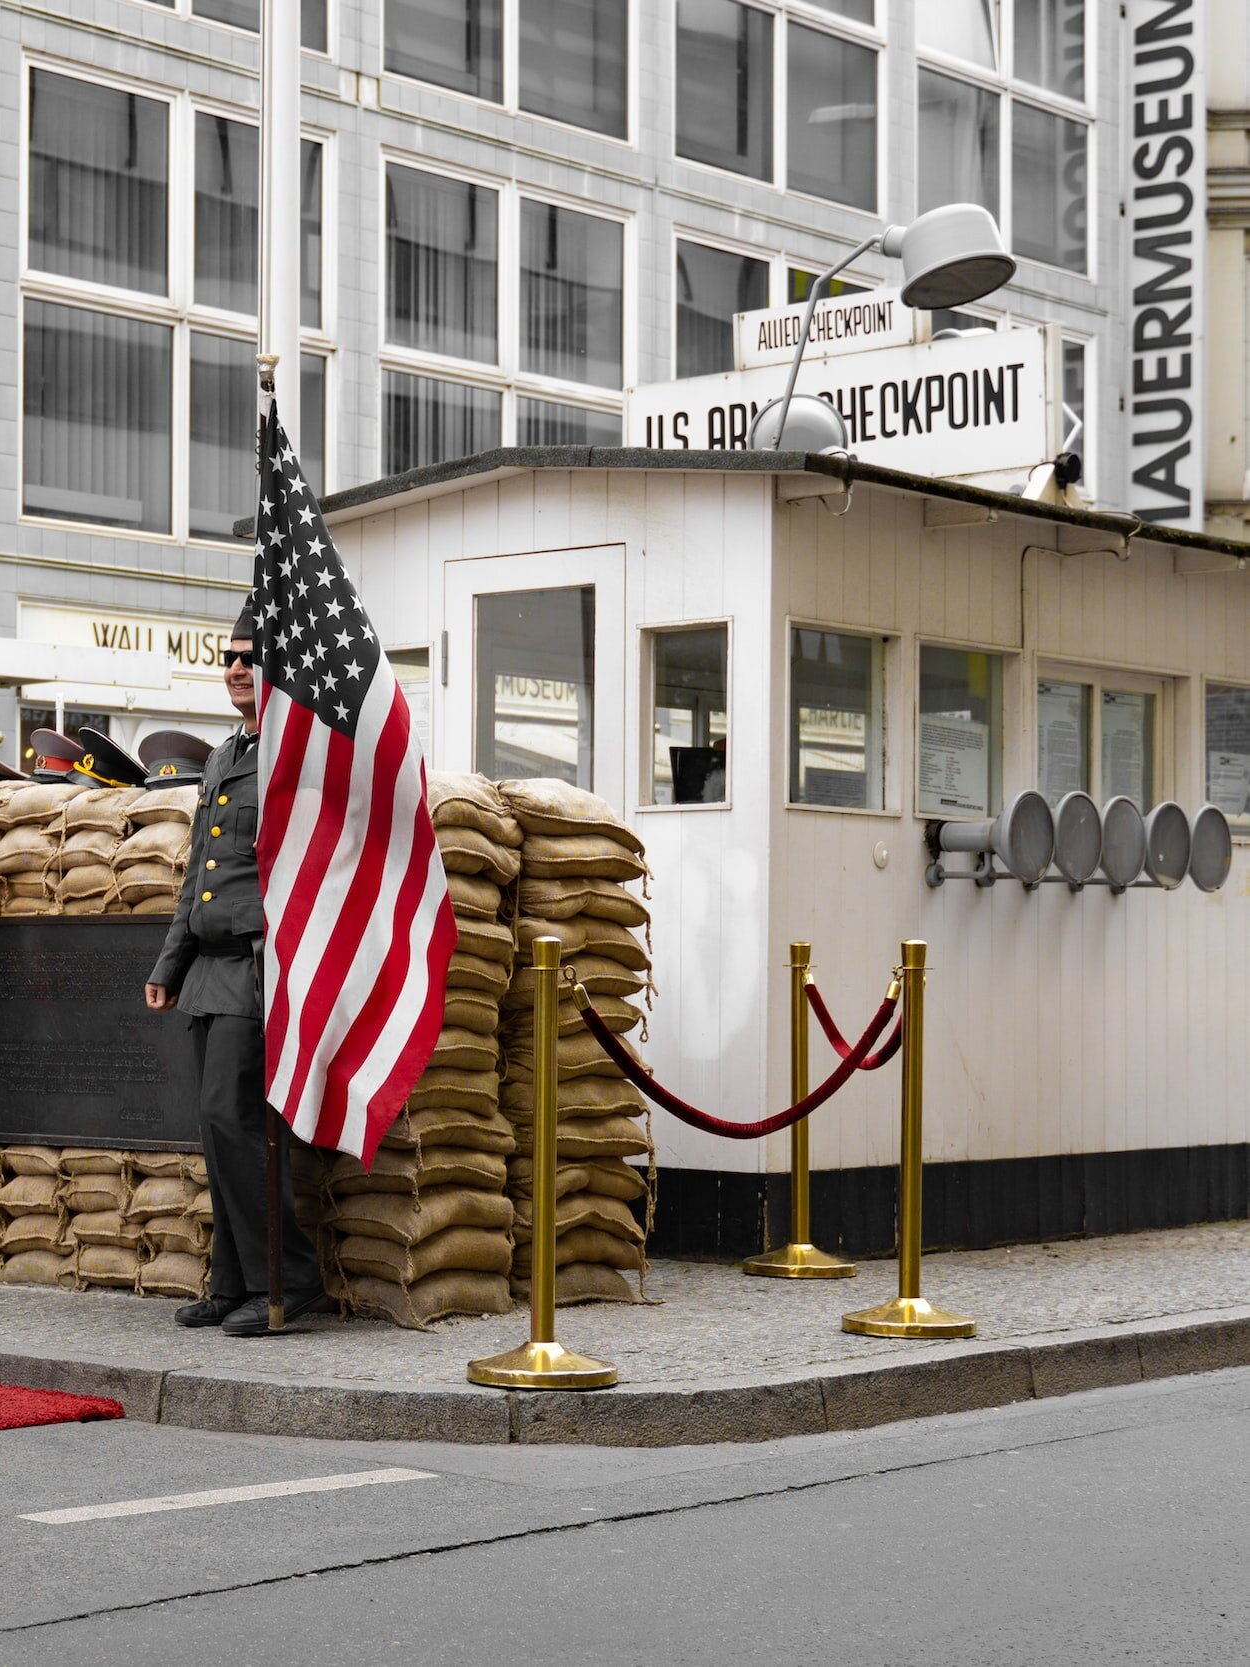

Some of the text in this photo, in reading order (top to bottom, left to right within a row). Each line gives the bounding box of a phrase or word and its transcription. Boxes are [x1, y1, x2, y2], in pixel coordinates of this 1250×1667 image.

[1132, 0, 1194, 523] AUERMUSEU
[758, 315, 800, 351] ALLIED
[168, 630, 228, 667] MUSE
